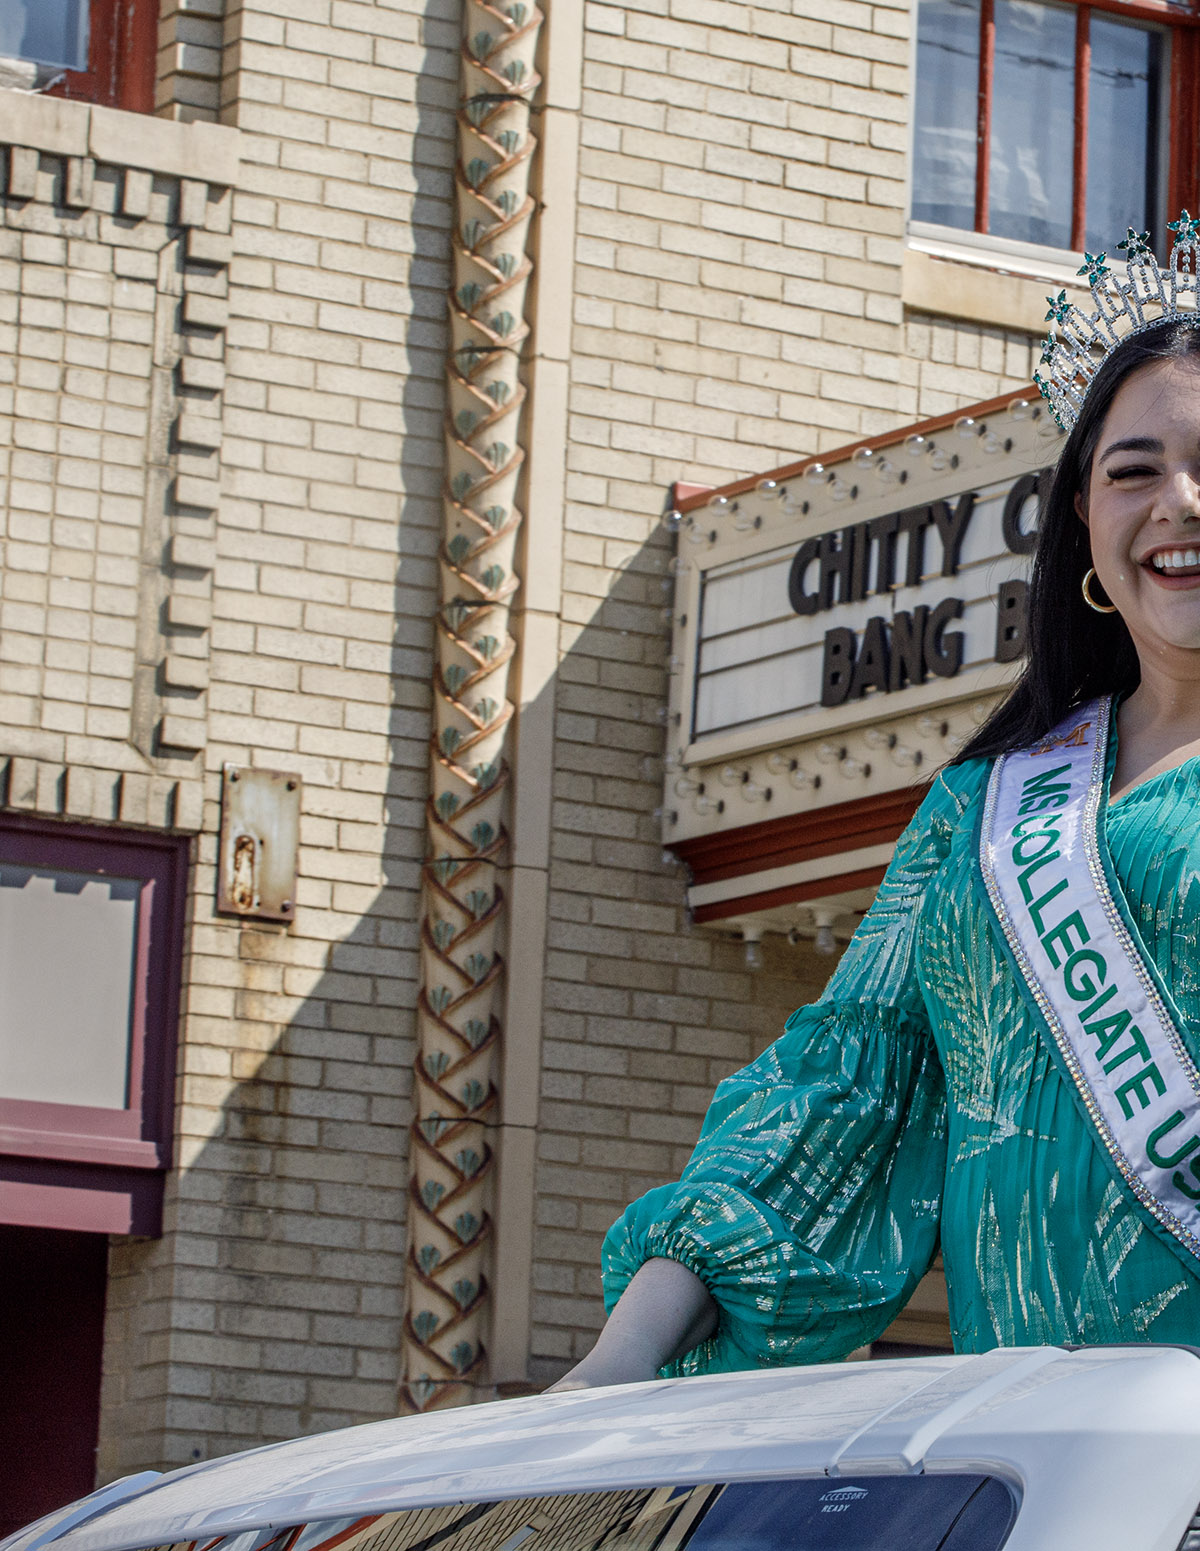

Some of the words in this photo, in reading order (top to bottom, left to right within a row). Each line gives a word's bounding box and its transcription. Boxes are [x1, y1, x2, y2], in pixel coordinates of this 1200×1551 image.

[789, 493, 979, 615] CHITTY
[821, 597, 965, 707] BANG
[1011, 813, 1168, 1121] COLLEGIATE
[819, 1491, 869, 1501] ACCESSORY
[821, 1504, 850, 1513] READY
